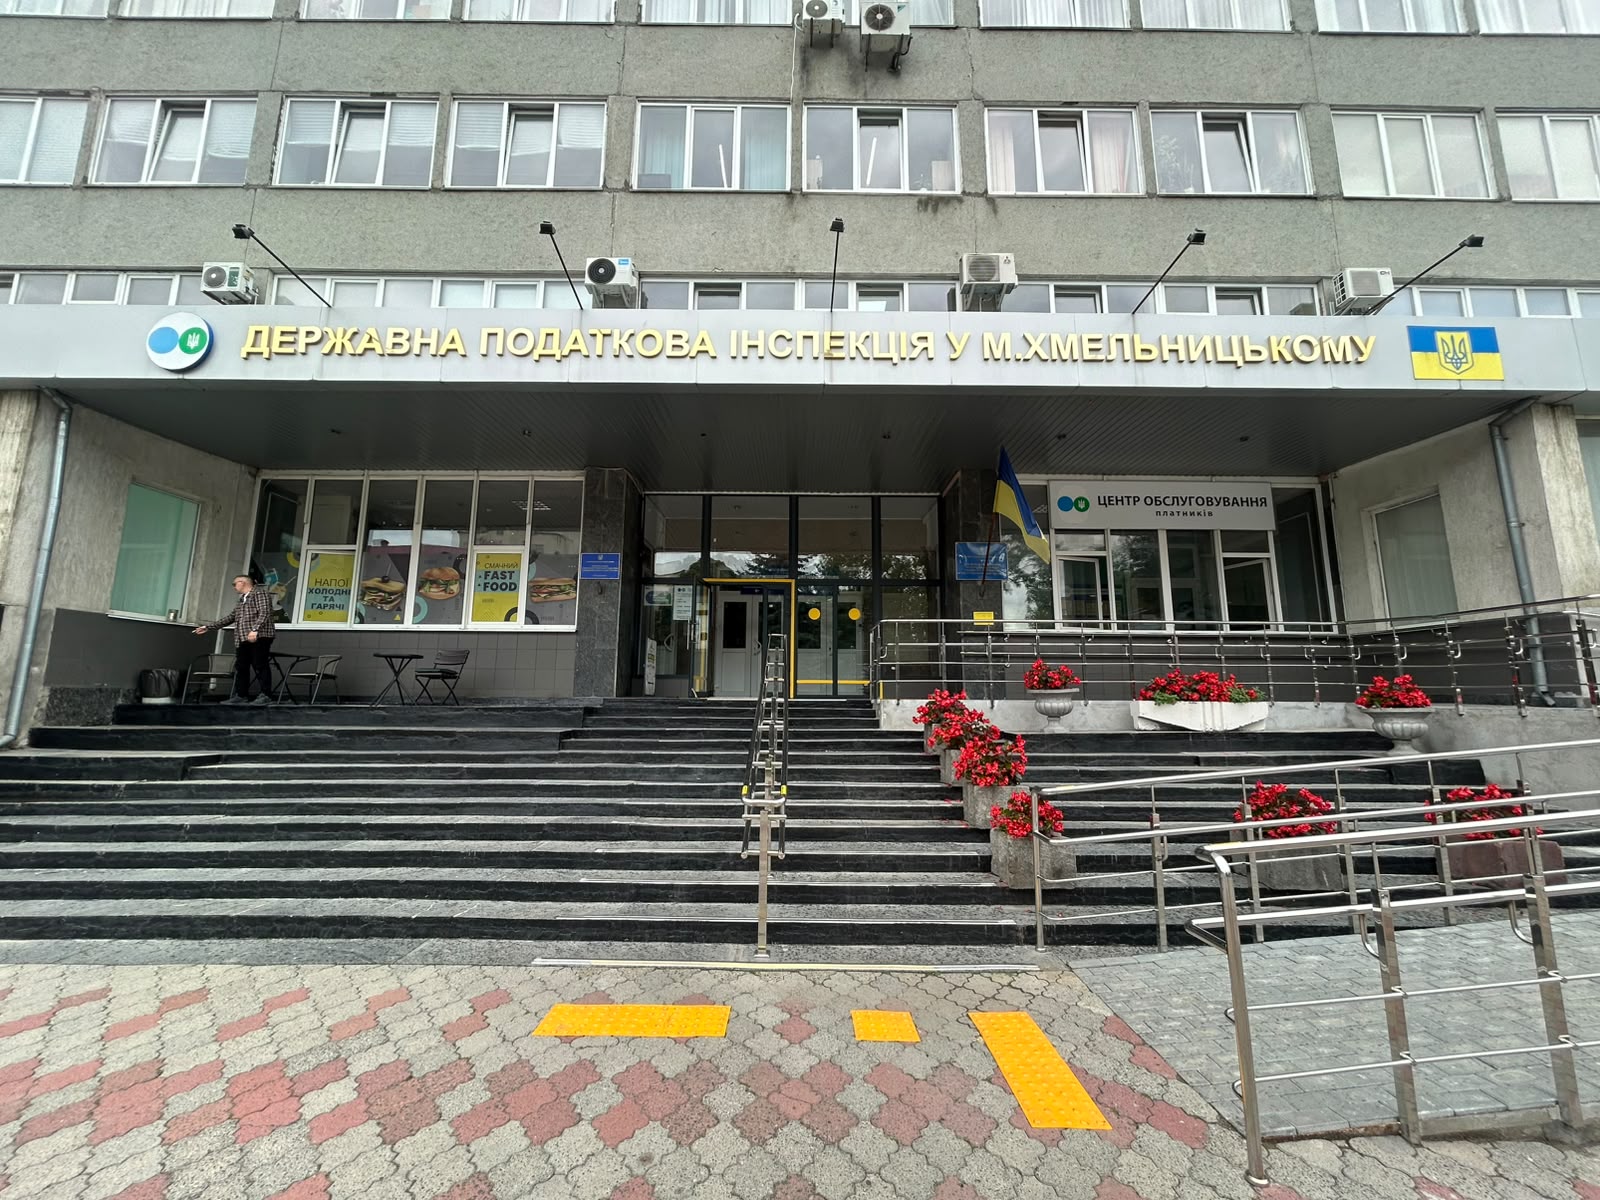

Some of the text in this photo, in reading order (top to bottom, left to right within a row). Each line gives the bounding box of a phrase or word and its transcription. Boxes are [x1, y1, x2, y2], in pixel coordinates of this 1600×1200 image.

[240, 325, 1377, 368] ДЕРЖАВНА ПОДАТКОВА ІНСПЕКЦІЯ У М.ХМЕЛЬНИЦЬКОМУ
[1097, 495, 1268, 508] ЦЕНТР ОБСЛУГОВУВАННЯ
[1155, 509, 1214, 517] платників
[483, 570, 515, 580] FAST
[314, 577, 350, 588] НАПОЇ
[482, 581, 518, 592] FOOD
